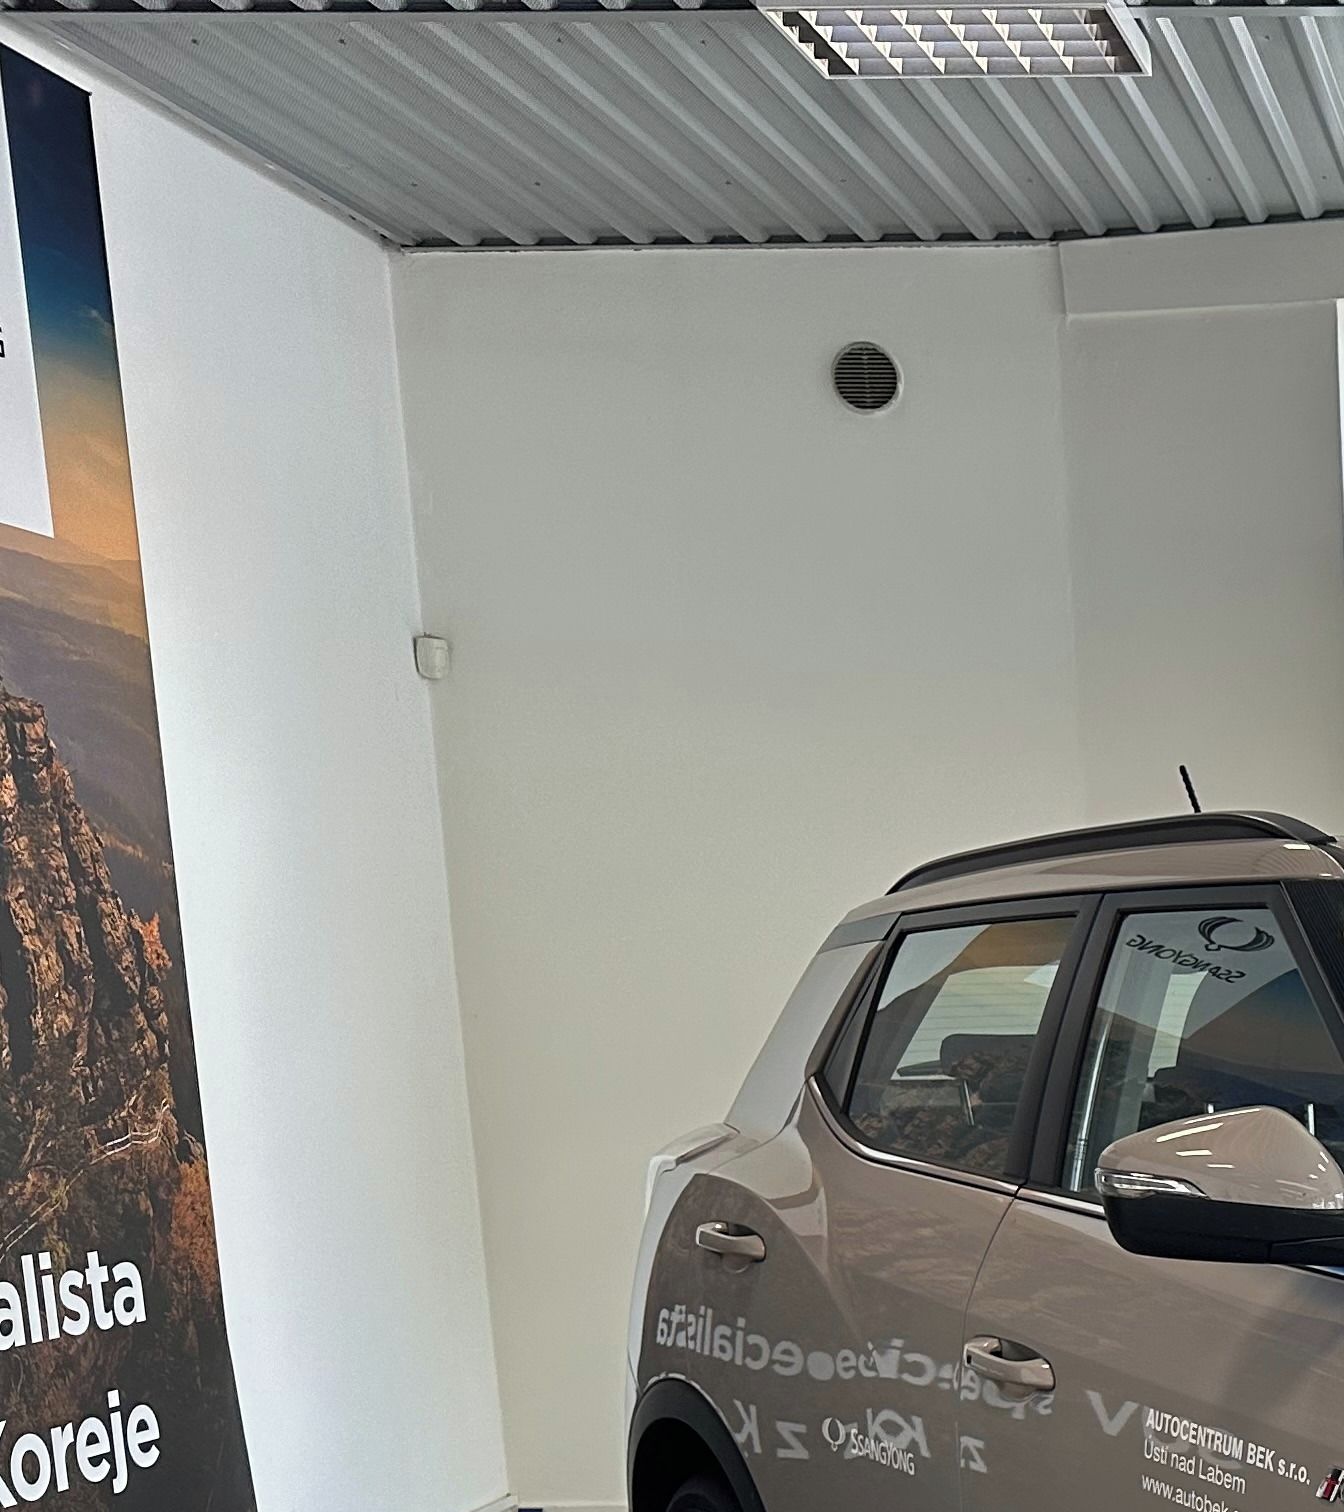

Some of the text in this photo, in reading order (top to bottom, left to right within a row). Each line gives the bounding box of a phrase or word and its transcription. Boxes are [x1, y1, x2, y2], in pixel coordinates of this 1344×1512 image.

[1146, 1408, 1243, 1461] AUTOCENTRUM
[1246, 1442, 1275, 1472] BEK
[1277, 1458, 1312, 1486] s.r.o.
[1170, 1450, 1195, 1475] nad
[1199, 1458, 1247, 1495] Labem
